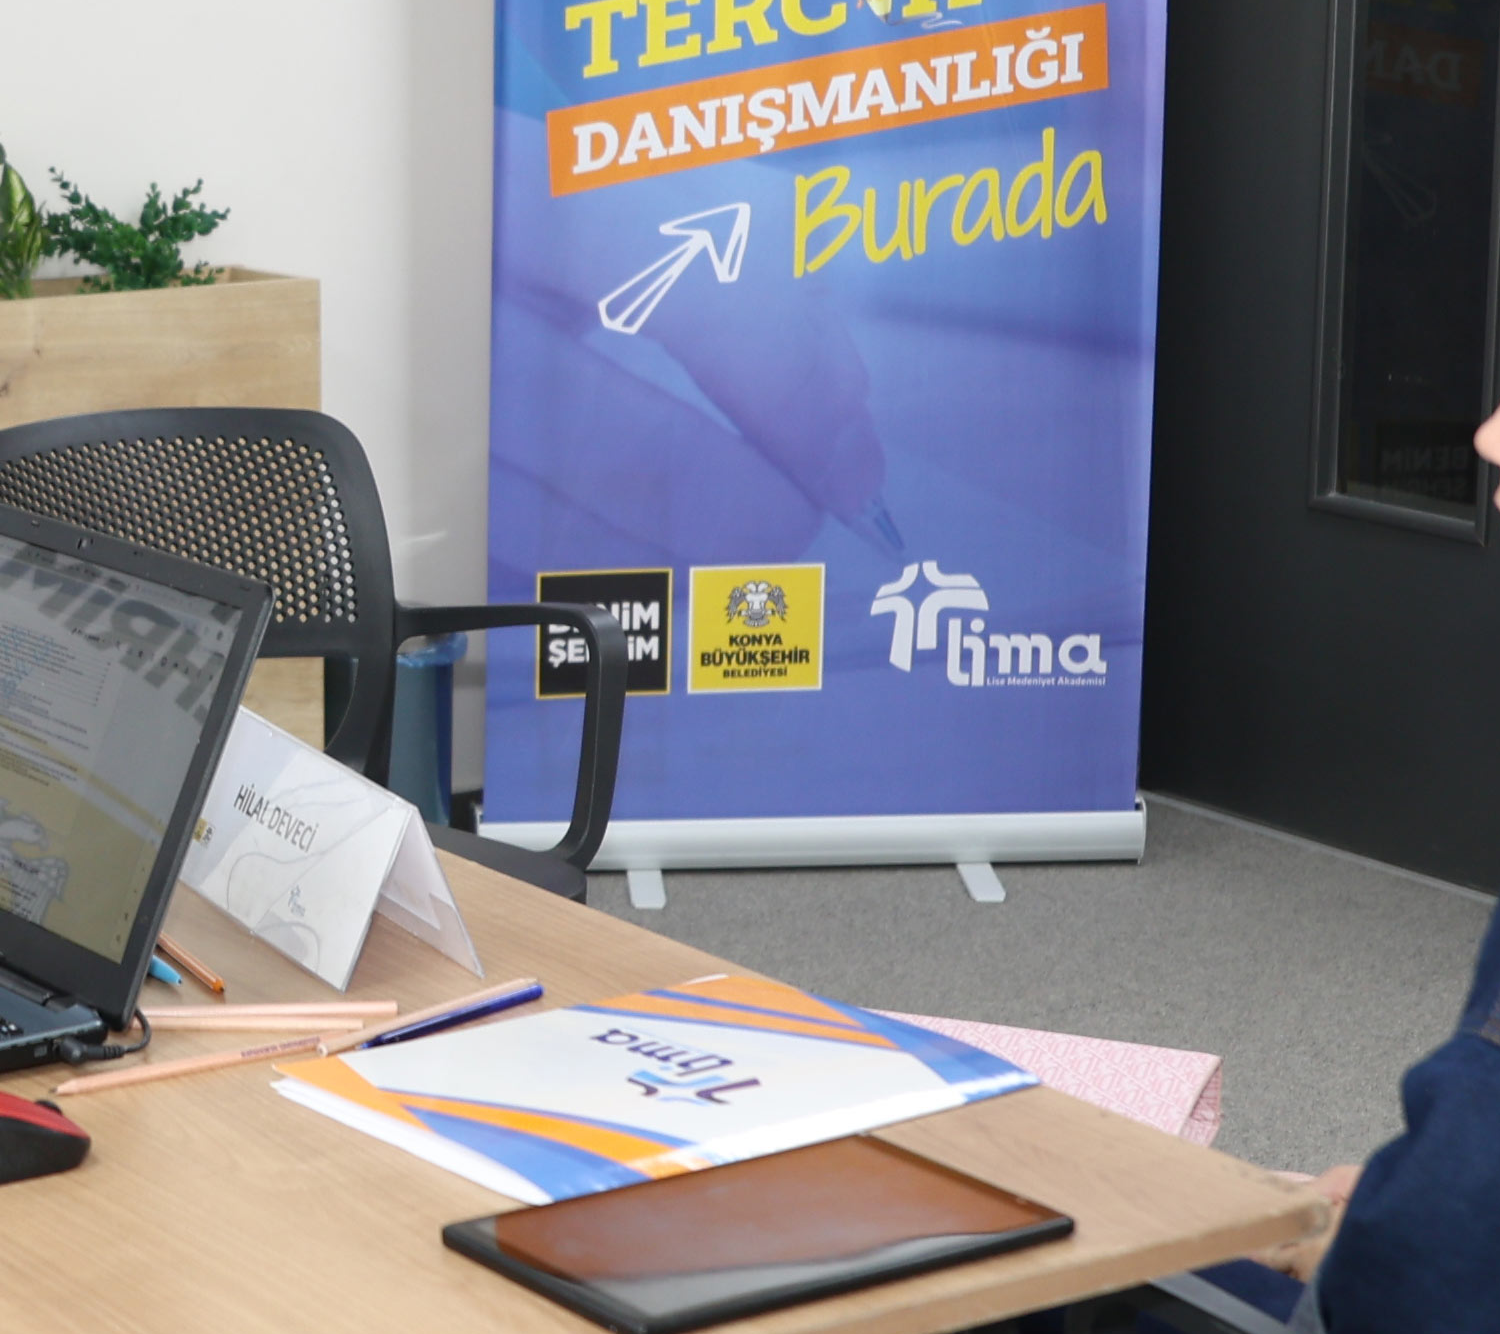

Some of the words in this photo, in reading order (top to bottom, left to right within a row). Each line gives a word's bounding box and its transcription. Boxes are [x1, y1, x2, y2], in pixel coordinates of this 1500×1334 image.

[572, 25, 1085, 175] DANIŞMANLIĞI
[793, 127, 1108, 279] Burada
[548, 635, 660, 669] ŞEİM
[700, 645, 811, 668] BÜYÜKŞEHİR
[728, 633, 783, 648] KONYA
[946, 617, 1107, 687] lima
[722, 666, 789, 679] BELEDİYESİ
[986, 676, 1005, 686] Lise
[1007, 676, 1056, 688] Medeniyet
[1057, 675, 1107, 687] Akademisi
[233, 782, 270, 826] HİLAL
[267, 804, 320, 854] DEVECİ
